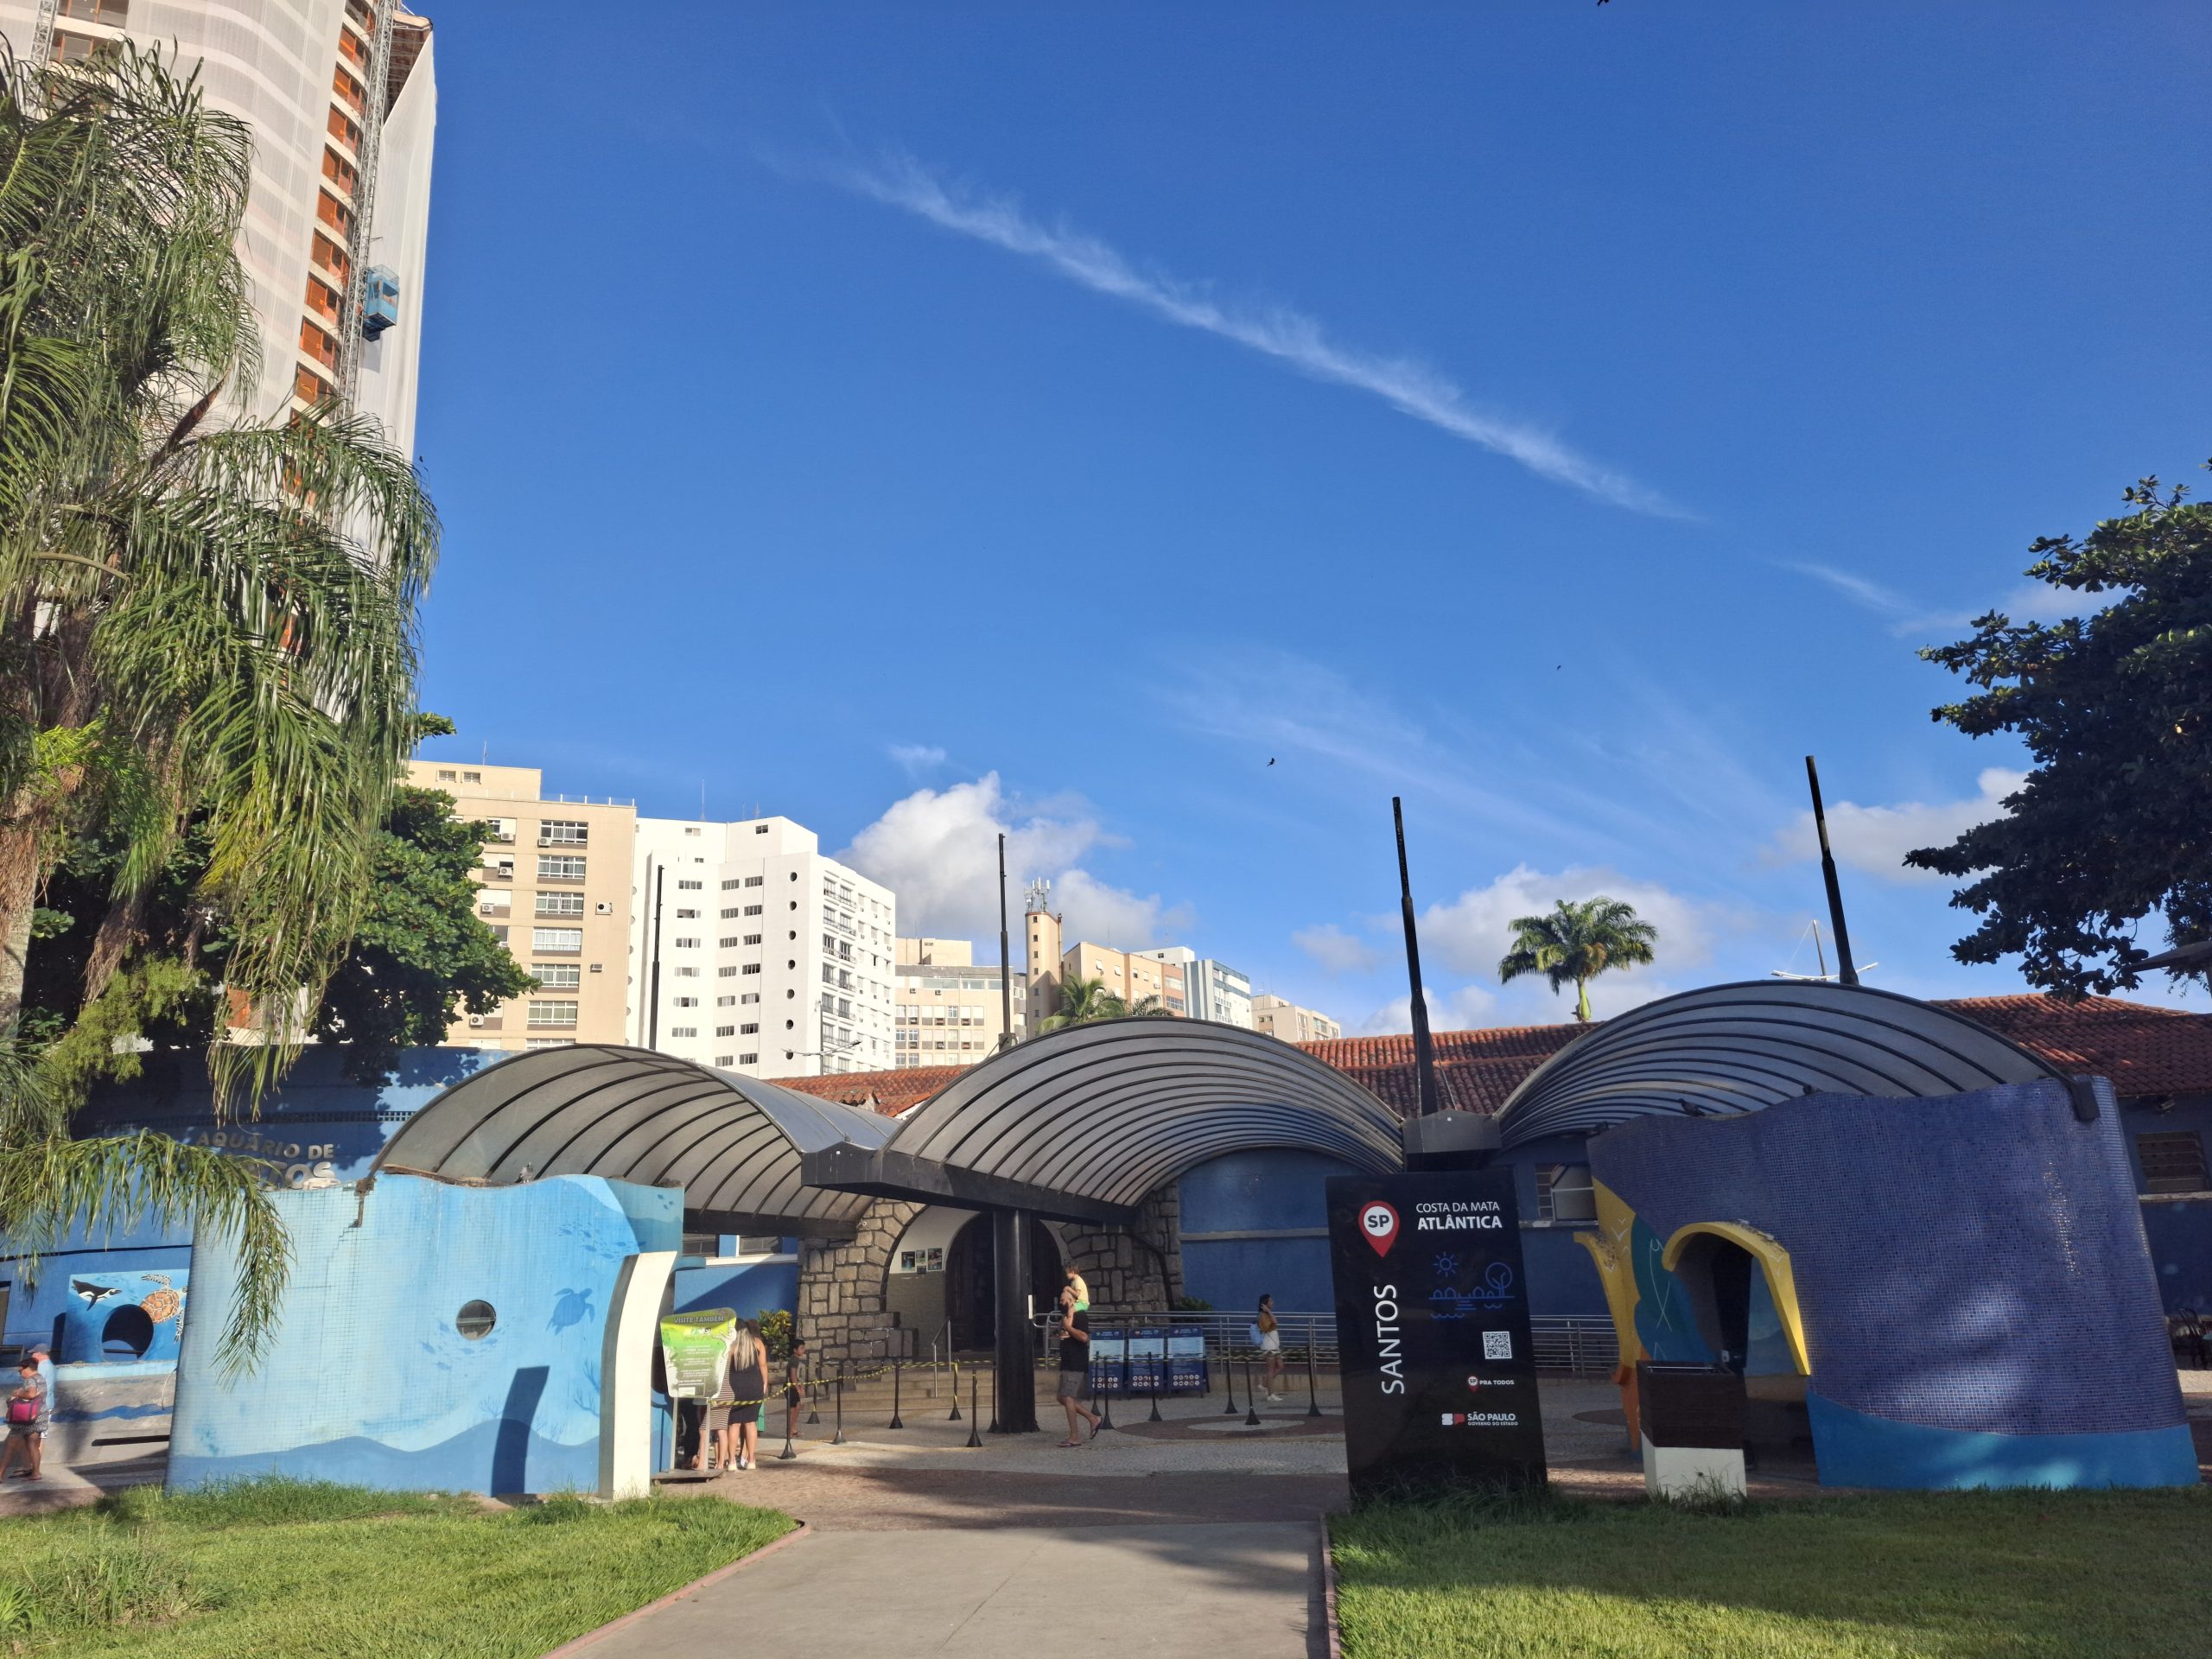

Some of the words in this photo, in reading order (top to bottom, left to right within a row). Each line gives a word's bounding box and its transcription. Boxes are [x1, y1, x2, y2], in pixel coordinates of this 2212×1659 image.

[196, 1130, 301, 1159] AQUÁRIO
[308, 1143, 334, 1160] DE
[1415, 1202, 1451, 1214] COSTA
[1452, 1202, 1469, 1212] DA
[1471, 1201, 1500, 1211] MATA
[1367, 1214, 1390, 1229] SP
[1417, 1214, 1503, 1230] ATLÂNTICA
[1373, 1284, 1405, 1395] SANTOS
[1467, 1411, 1485, 1421] SÃO
[1487, 1413, 1516, 1421] PAULO
